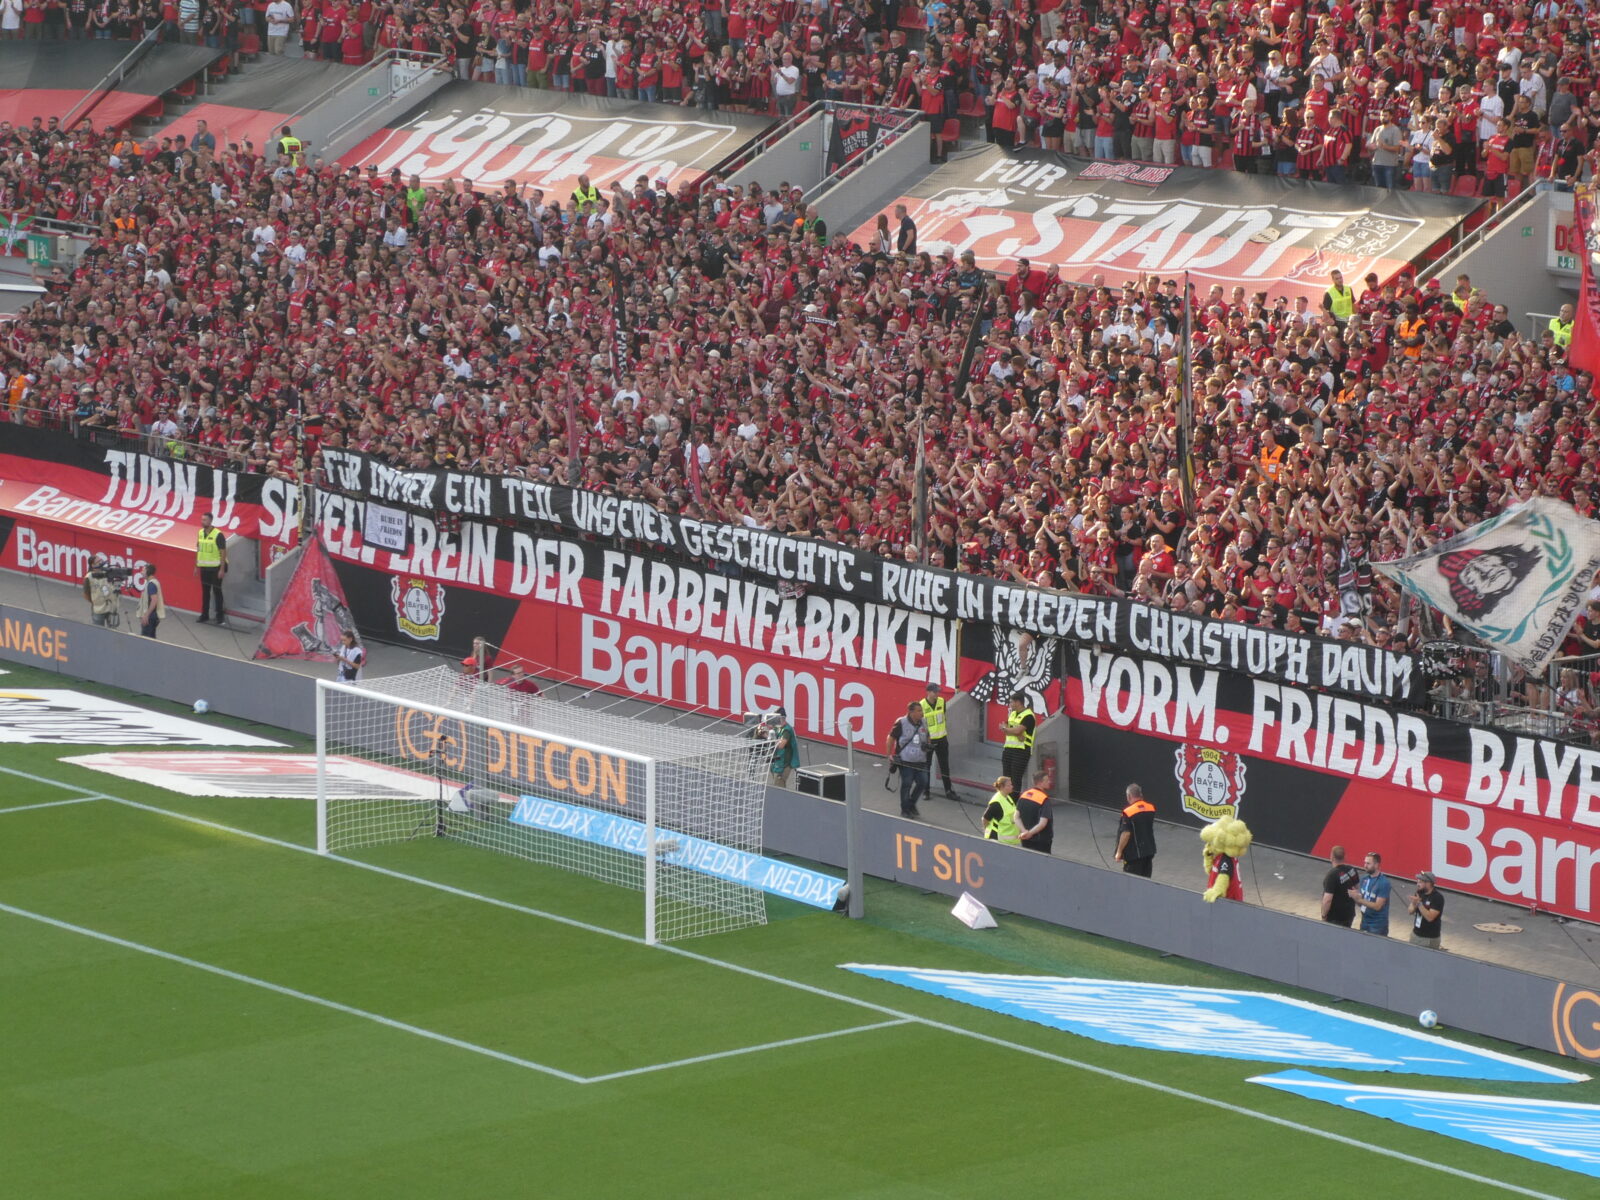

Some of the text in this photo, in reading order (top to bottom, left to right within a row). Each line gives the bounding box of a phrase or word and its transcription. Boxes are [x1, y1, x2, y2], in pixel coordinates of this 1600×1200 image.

[974, 158, 1067, 192] FÜR
[997, 197, 1347, 277] STADT
[14, 485, 175, 540] Barmenia
[322, 449, 361, 491] FÜR
[369, 461, 437, 509] IMMER
[446, 473, 491, 516] EIN
[502, 478, 561, 524] TEIL
[571, 489, 676, 546] UNSERER
[679, 518, 855, 591] GESCHICHTE
[882, 562, 949, 615] RUHE
[956, 577, 985, 620] IN
[992, 585, 1118, 643] FRIEDEN
[1129, 604, 1311, 683] CHRISTOPH
[1322, 643, 1412, 699] DAUM
[100, 449, 198, 521] TURN
[212, 469, 241, 530] U.
[510, 532, 584, 608] DER
[600, 550, 956, 689] FARBENFABRIKEN
[1078, 649, 1230, 744] VORM.
[1248, 678, 1443, 794] FRIEDR.
[581, 613, 876, 746] Barmenia
[487, 726, 628, 806] DITCON
[1196, 777, 1224, 790] BAYER
[1188, 797, 1232, 817] Leverkusen
[514, 797, 597, 836] NIEDAX
[680, 838, 755, 881] NIEDAX
[761, 863, 842, 907] NIEDAX
[896, 833, 923, 872] IT
